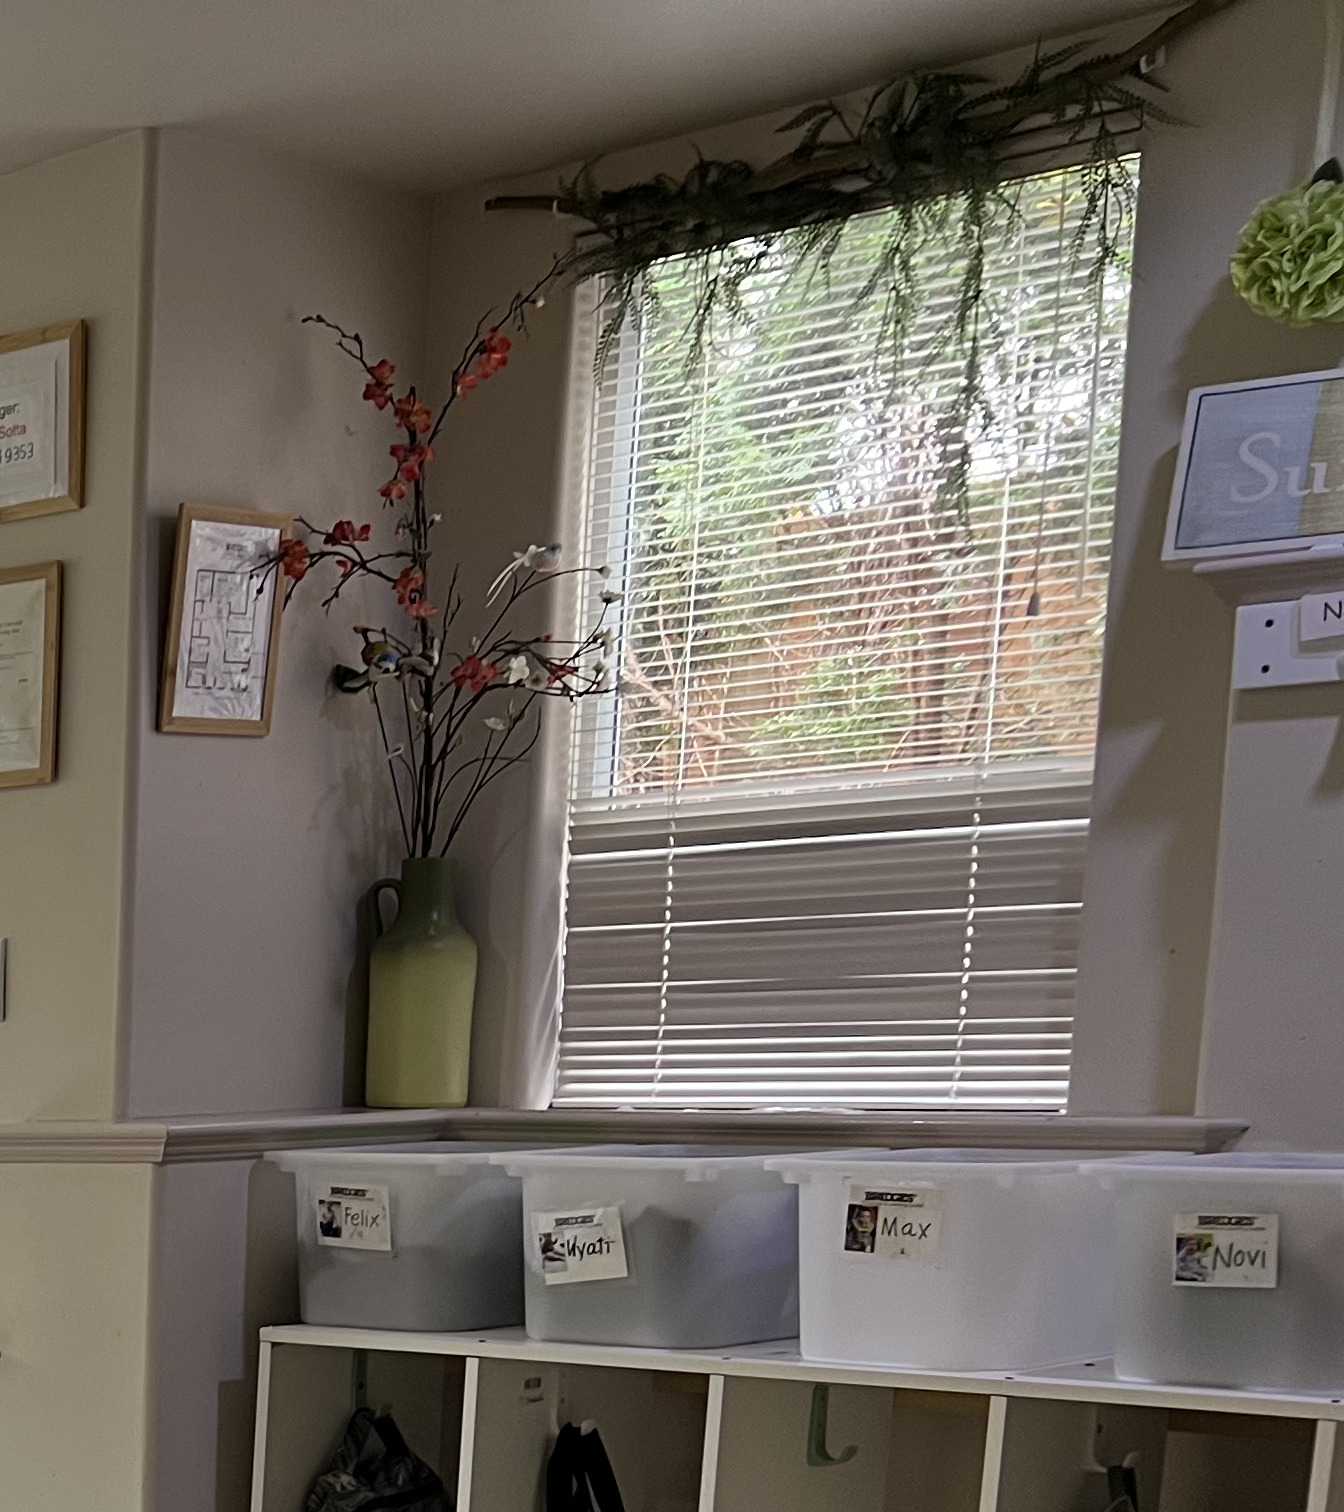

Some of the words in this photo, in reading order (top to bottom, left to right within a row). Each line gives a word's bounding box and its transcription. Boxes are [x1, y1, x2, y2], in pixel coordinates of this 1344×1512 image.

[1229, 431, 1344, 501] Su
[344, 1206, 381, 1228] Felix
[881, 1217, 932, 1240] Max
[1212, 1243, 1267, 1271] Novi
